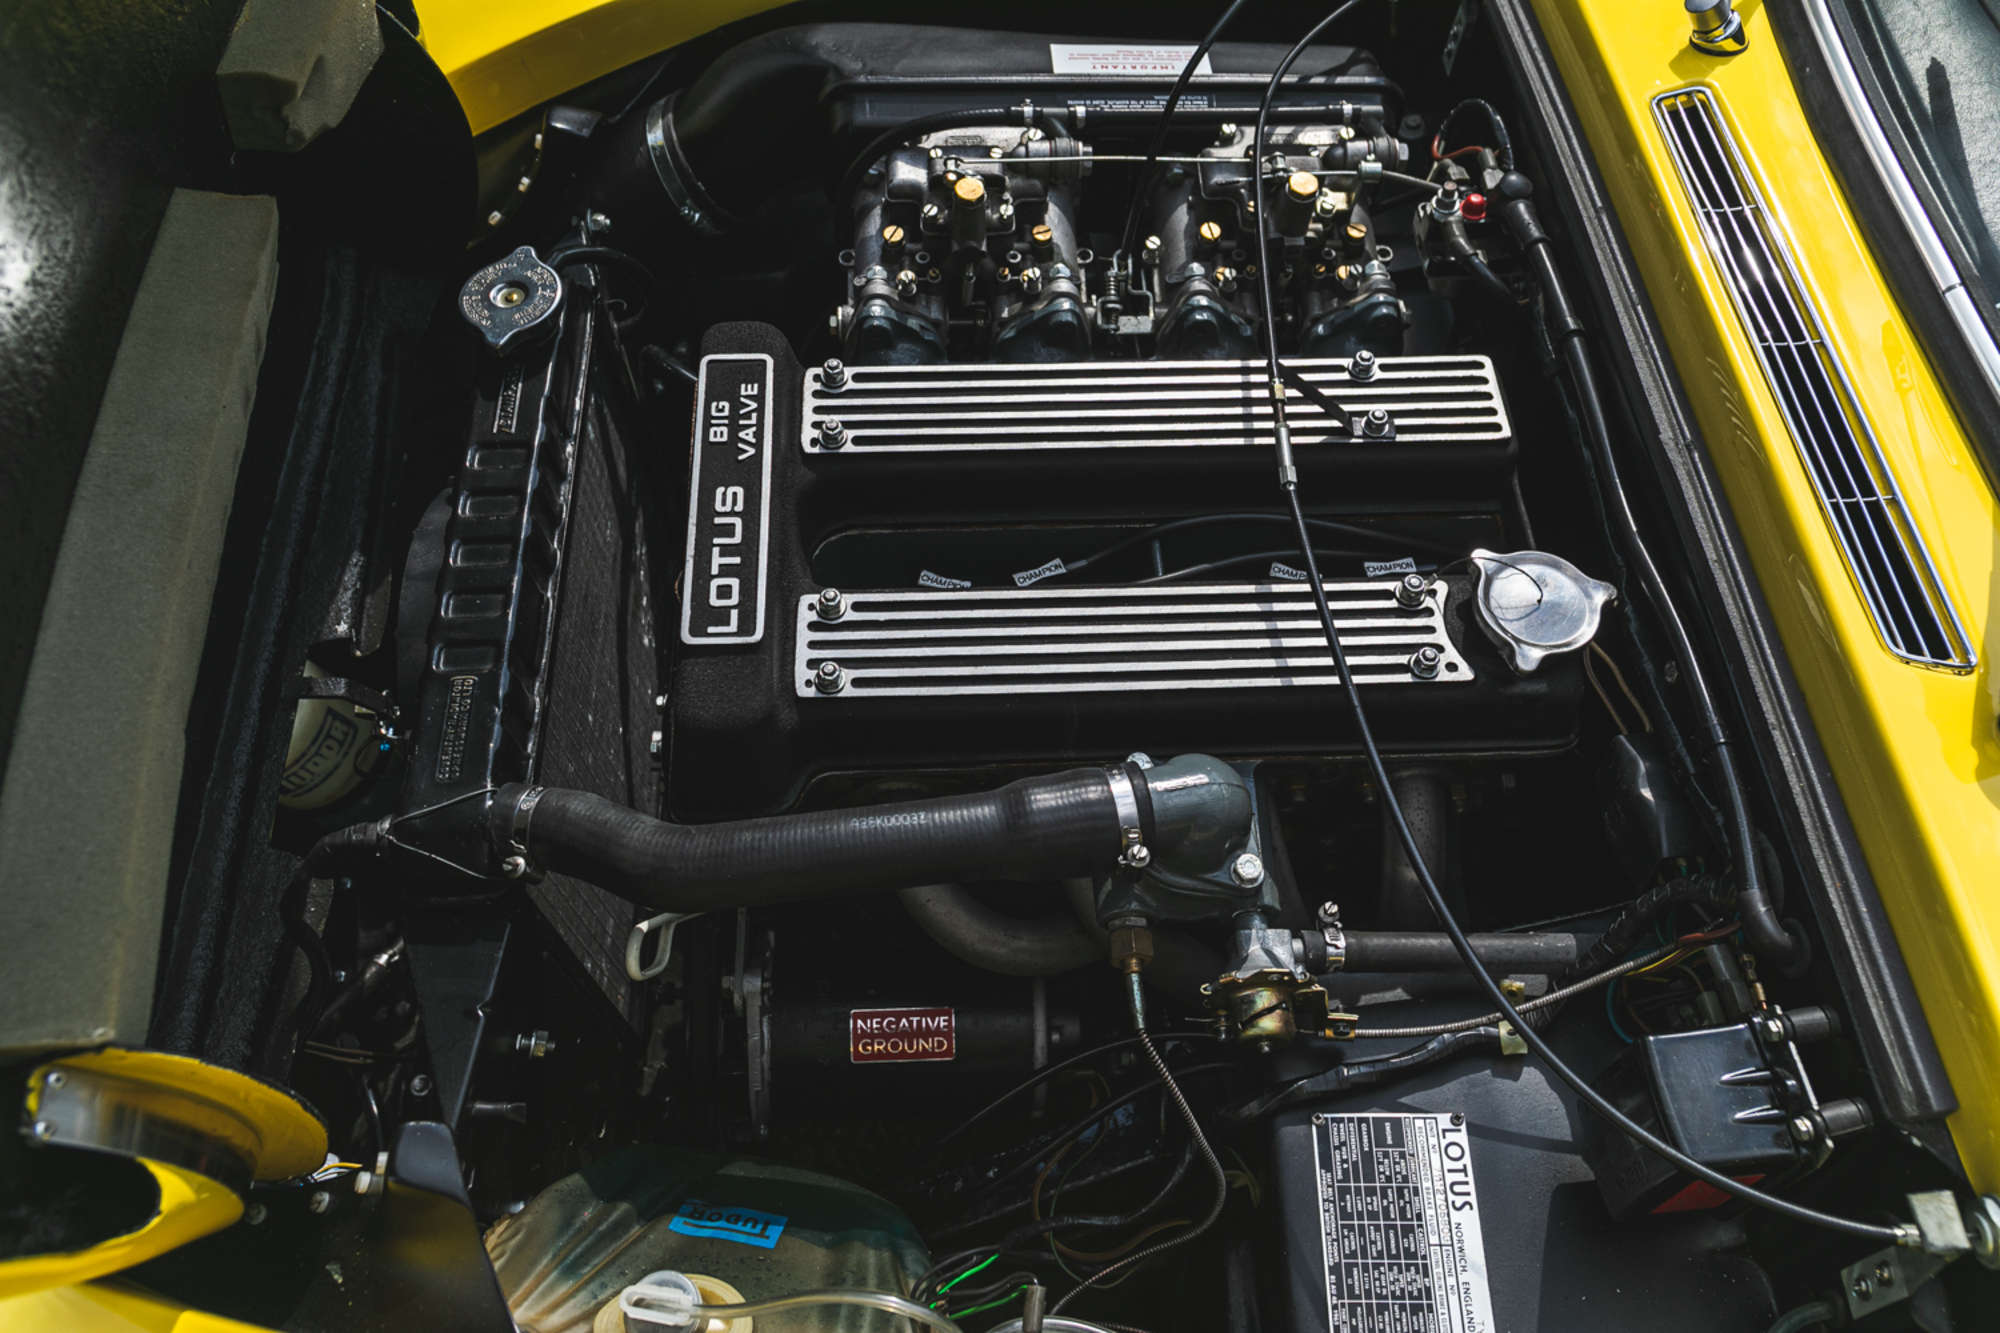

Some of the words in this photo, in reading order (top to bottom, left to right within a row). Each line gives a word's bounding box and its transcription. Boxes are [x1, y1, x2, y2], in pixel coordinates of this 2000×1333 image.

[709, 400, 730, 442] BIG
[737, 382, 759, 460] VALVE
[707, 485, 745, 633] LOTUS
[1016, 561, 1063, 585] CHAMPION
[1272, 565, 1310, 580] CHAMP
[1366, 560, 1414, 574] CHAMPION
[921, 573, 971, 589] CHAMPION
[857, 1015, 949, 1034] NEGATIVE
[857, 1036, 948, 1055] GROUND
[1348, 1122, 1357, 1161] DIFFERENTIAL
[1360, 1123, 1369, 1151] GEARBOX
[1417, 1126, 1430, 1182] RECOMMENDED
[1441, 1128, 1473, 1211] LOTUS
[1424, 1186, 1433, 1209] BRAKE
[686, 1207, 771, 1239] TUDOR
[1428, 1214, 1436, 1235] FLUID
[1417, 1227, 1426, 1255] CASTROL
[1444, 1248, 1453, 1277] ENGINE
[1453, 1222, 1468, 1275] NORWICH,
[1461, 1281, 1476, 1332] ENGLAND
